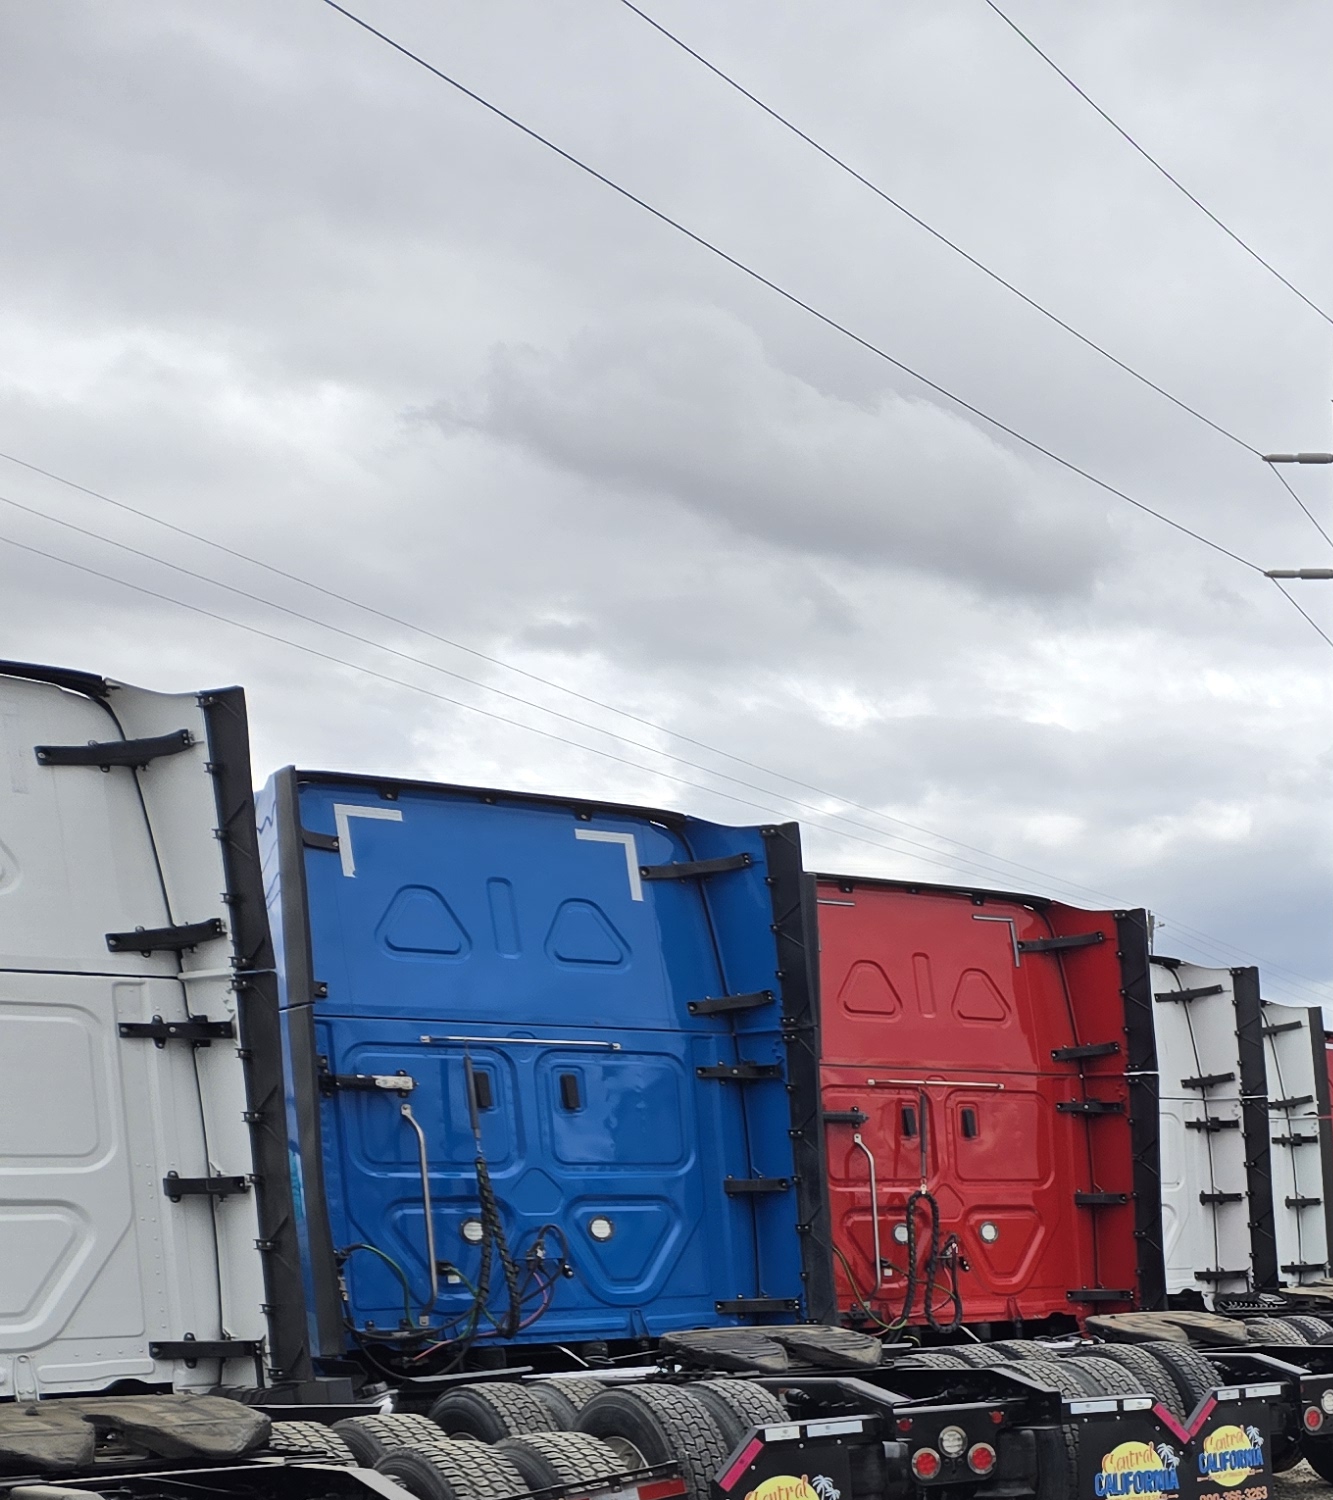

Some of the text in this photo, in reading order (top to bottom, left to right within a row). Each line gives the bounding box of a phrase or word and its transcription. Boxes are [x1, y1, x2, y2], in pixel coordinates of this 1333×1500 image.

[1102, 1441, 1155, 1473] Central
[1198, 1447, 1264, 1474] CALIFORNIA
[1094, 1468, 1180, 1496] CALIFORNIA
